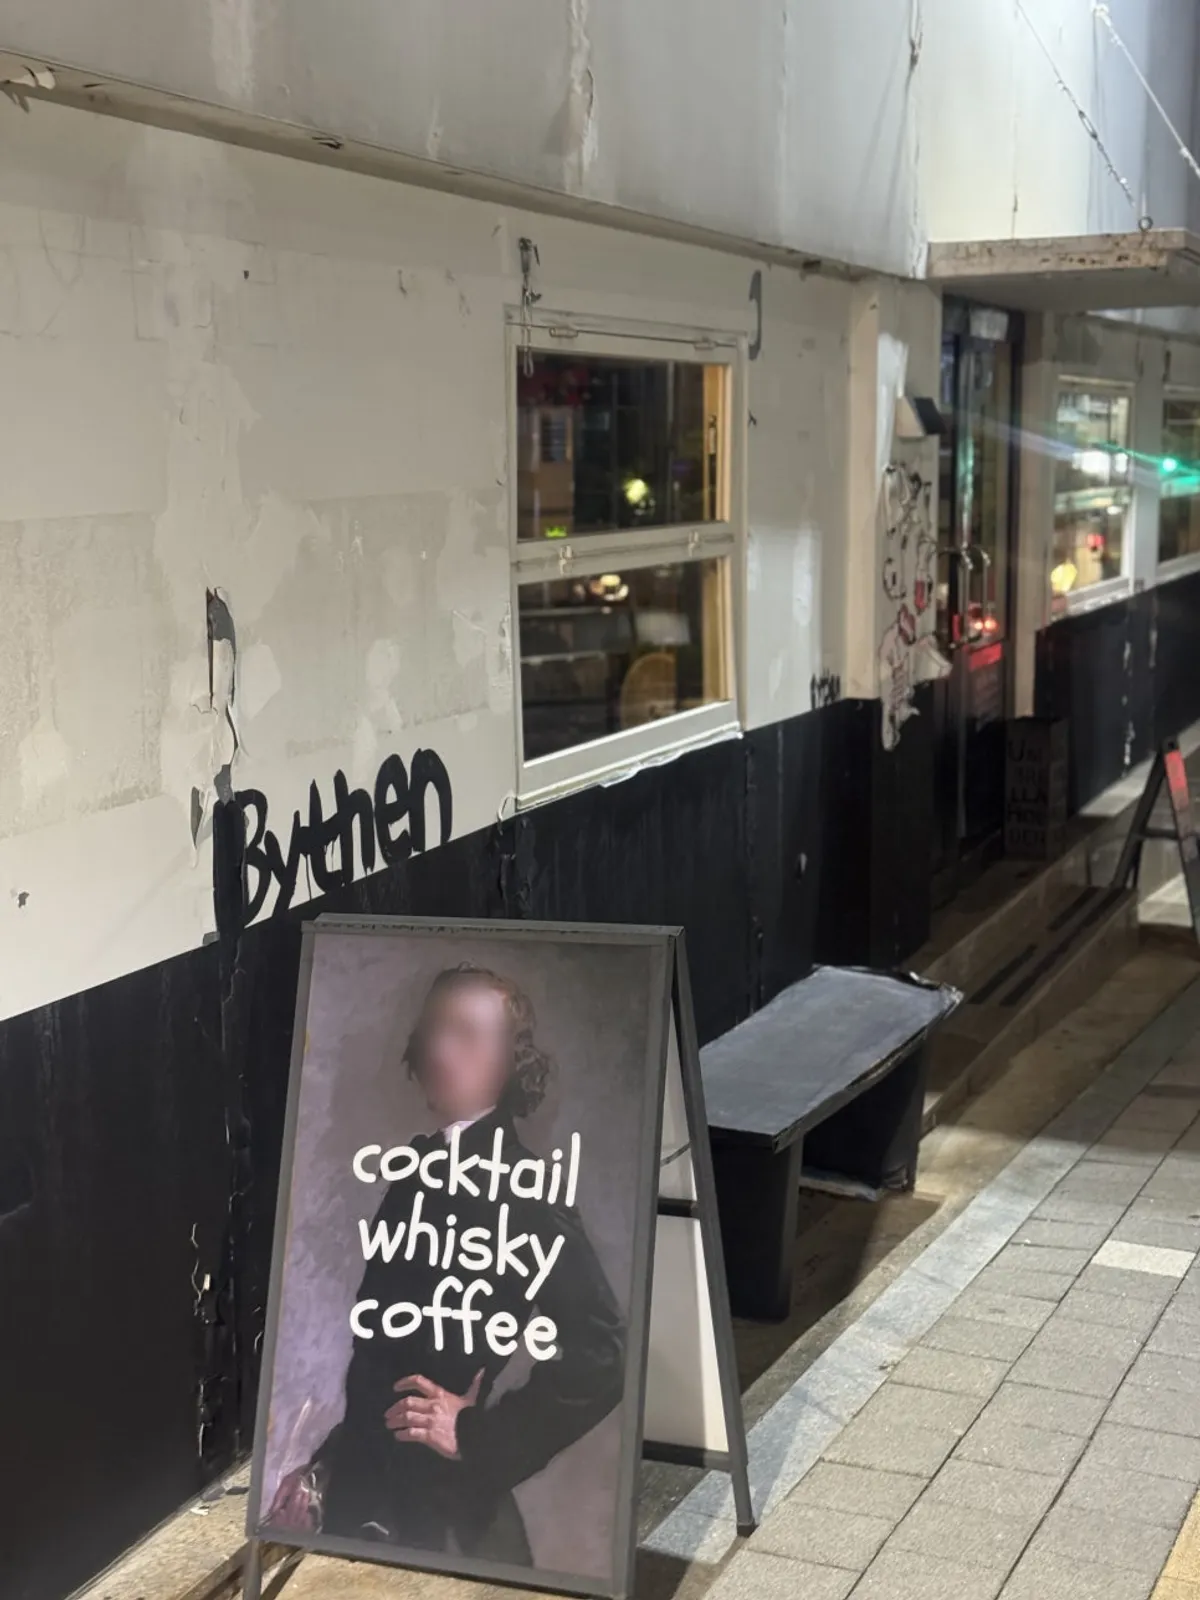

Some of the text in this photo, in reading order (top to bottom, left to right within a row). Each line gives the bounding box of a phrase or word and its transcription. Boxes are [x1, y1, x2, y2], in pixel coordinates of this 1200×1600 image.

[353, 1126, 580, 1207] cocktail
[359, 1191, 565, 1300] whisky
[350, 1276, 558, 1360] coffee
